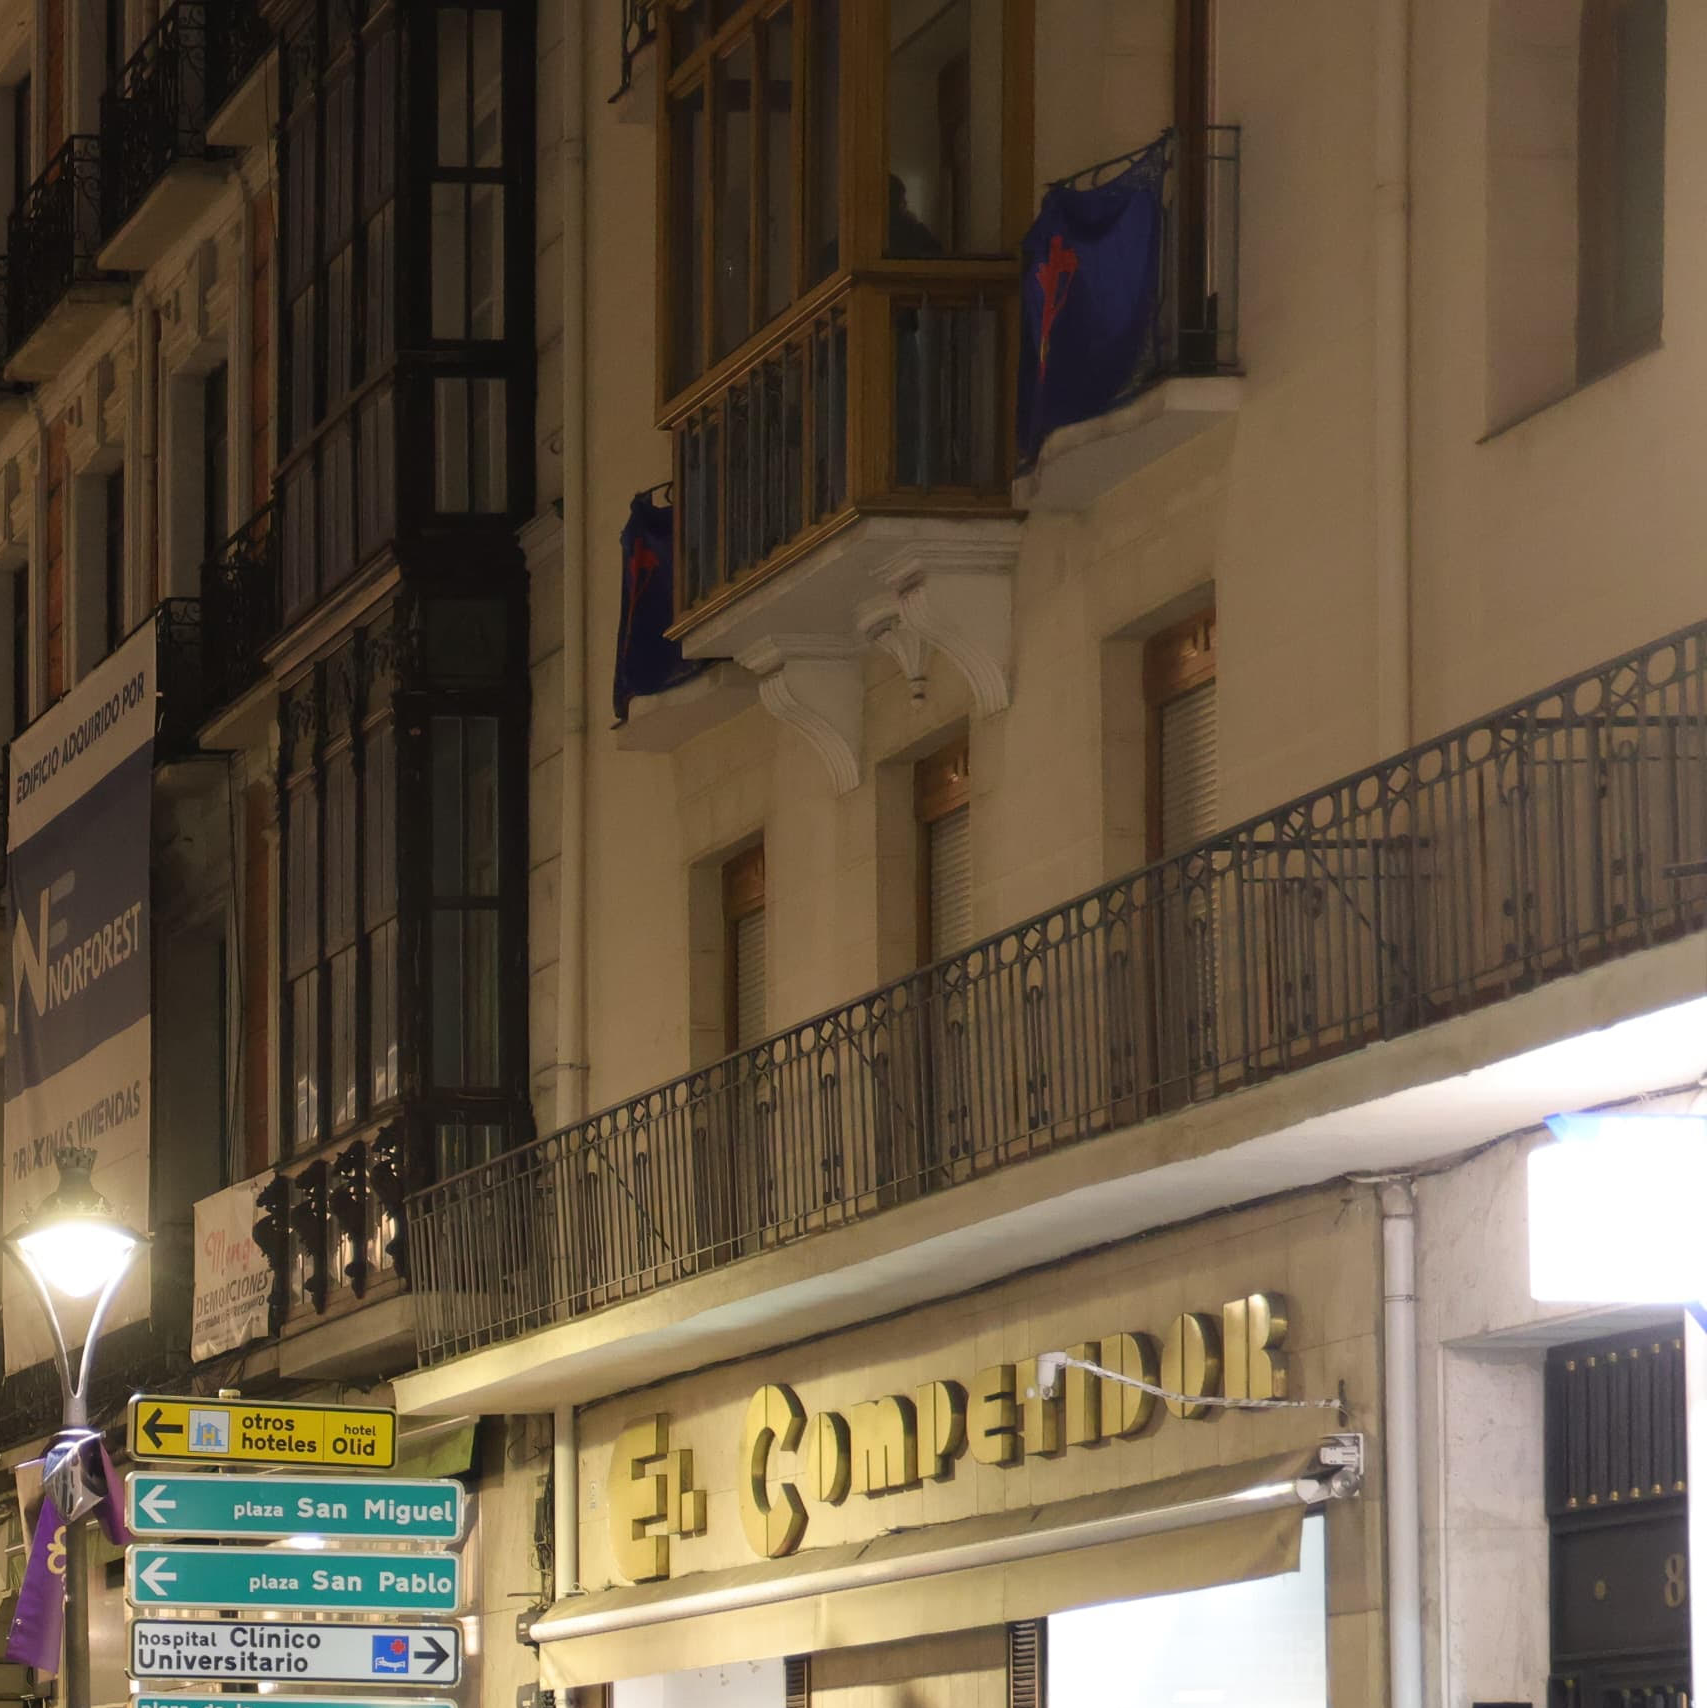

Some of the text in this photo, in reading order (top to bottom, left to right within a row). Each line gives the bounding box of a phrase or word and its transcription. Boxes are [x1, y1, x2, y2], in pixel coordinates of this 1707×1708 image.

[16, 671, 144, 805] EDIFICIO ADQUIRIDO POR
[48, 901, 141, 1009] NORFOREST
[76, 1079, 141, 1147] VIVIENDAS
[241, 1413, 295, 1431] otros
[343, 1424, 376, 1437] hotel
[241, 1432, 317, 1454] hoteles
[332, 1437, 376, 1457] Olid
[233, 1497, 454, 1525] plaza San Miguel
[248, 1570, 453, 1595] plaza San Pablo
[138, 1626, 321, 1650] hospital Clínico
[138, 1648, 309, 1673] Universitario
